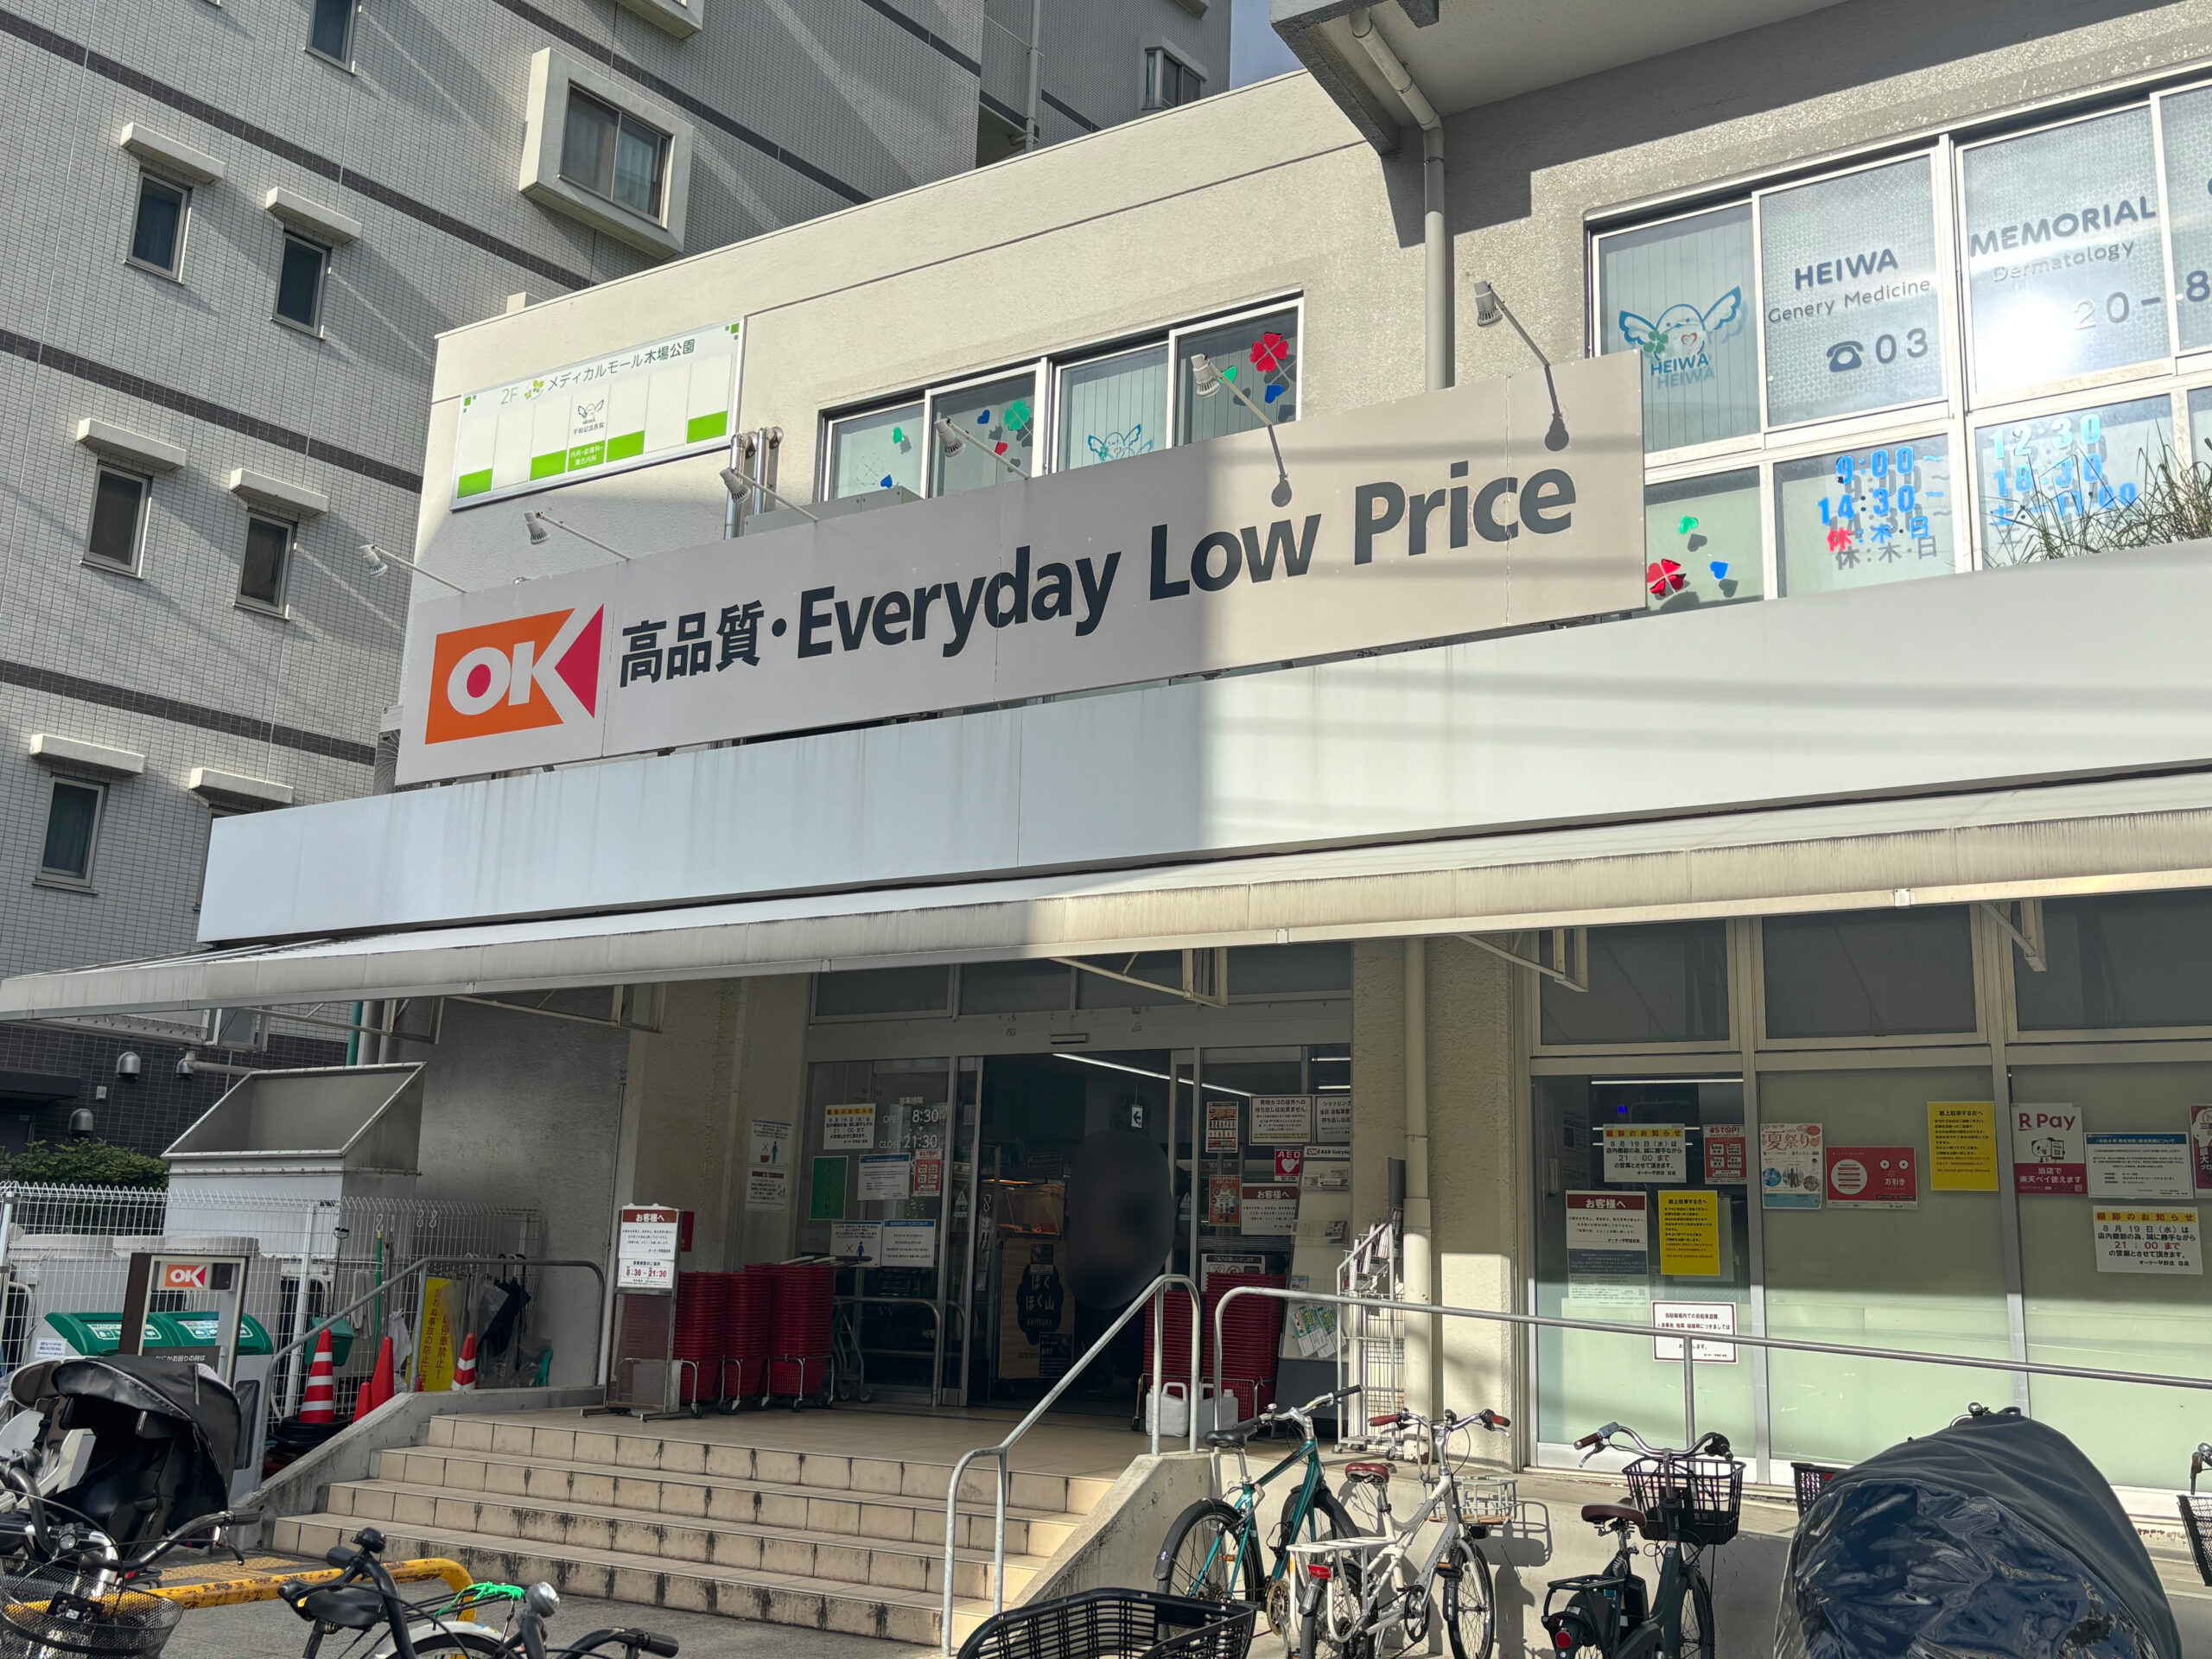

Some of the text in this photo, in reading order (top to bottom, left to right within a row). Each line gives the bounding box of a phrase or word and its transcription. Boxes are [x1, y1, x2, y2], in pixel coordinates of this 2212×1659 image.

[1969, 195, 2157, 257] MEMORIAL
[1993, 239, 2135, 283] Dermatology
[1795, 248, 1899, 291] HEIWA
[1768, 279, 1931, 324] Genery Medicine
[500, 338, 696, 405] 2F メディカルモール木場公園
[1650, 353, 1709, 377] HEIWA
[446, 603, 603, 725] OK
[1148, 512, 1322, 602] Low
[1353, 460, 1577, 566] Price
[912, 1109, 940, 1122] 8:30
[2018, 1112, 2076, 1131] R Pay
[903, 1134, 938, 1148] 21:30
[1764, 1130, 1811, 1151] 夏祭り
[1277, 1150, 1301, 1159] AED
[2037, 1166, 2063, 1175] 当店で
[1884, 1178, 1906, 1186] 万引き
[2018, 1175, 2082, 1184] 楽天ペイ使えます
[1256, 1188, 1290, 1200] お客様へ
[1586, 1198, 1626, 1209] お客様へ
[635, 1212, 665, 1223] お客様へ
[2096, 1211, 2194, 1222] 棚卸のお知らせ
[168, 1264, 207, 1288] OK
